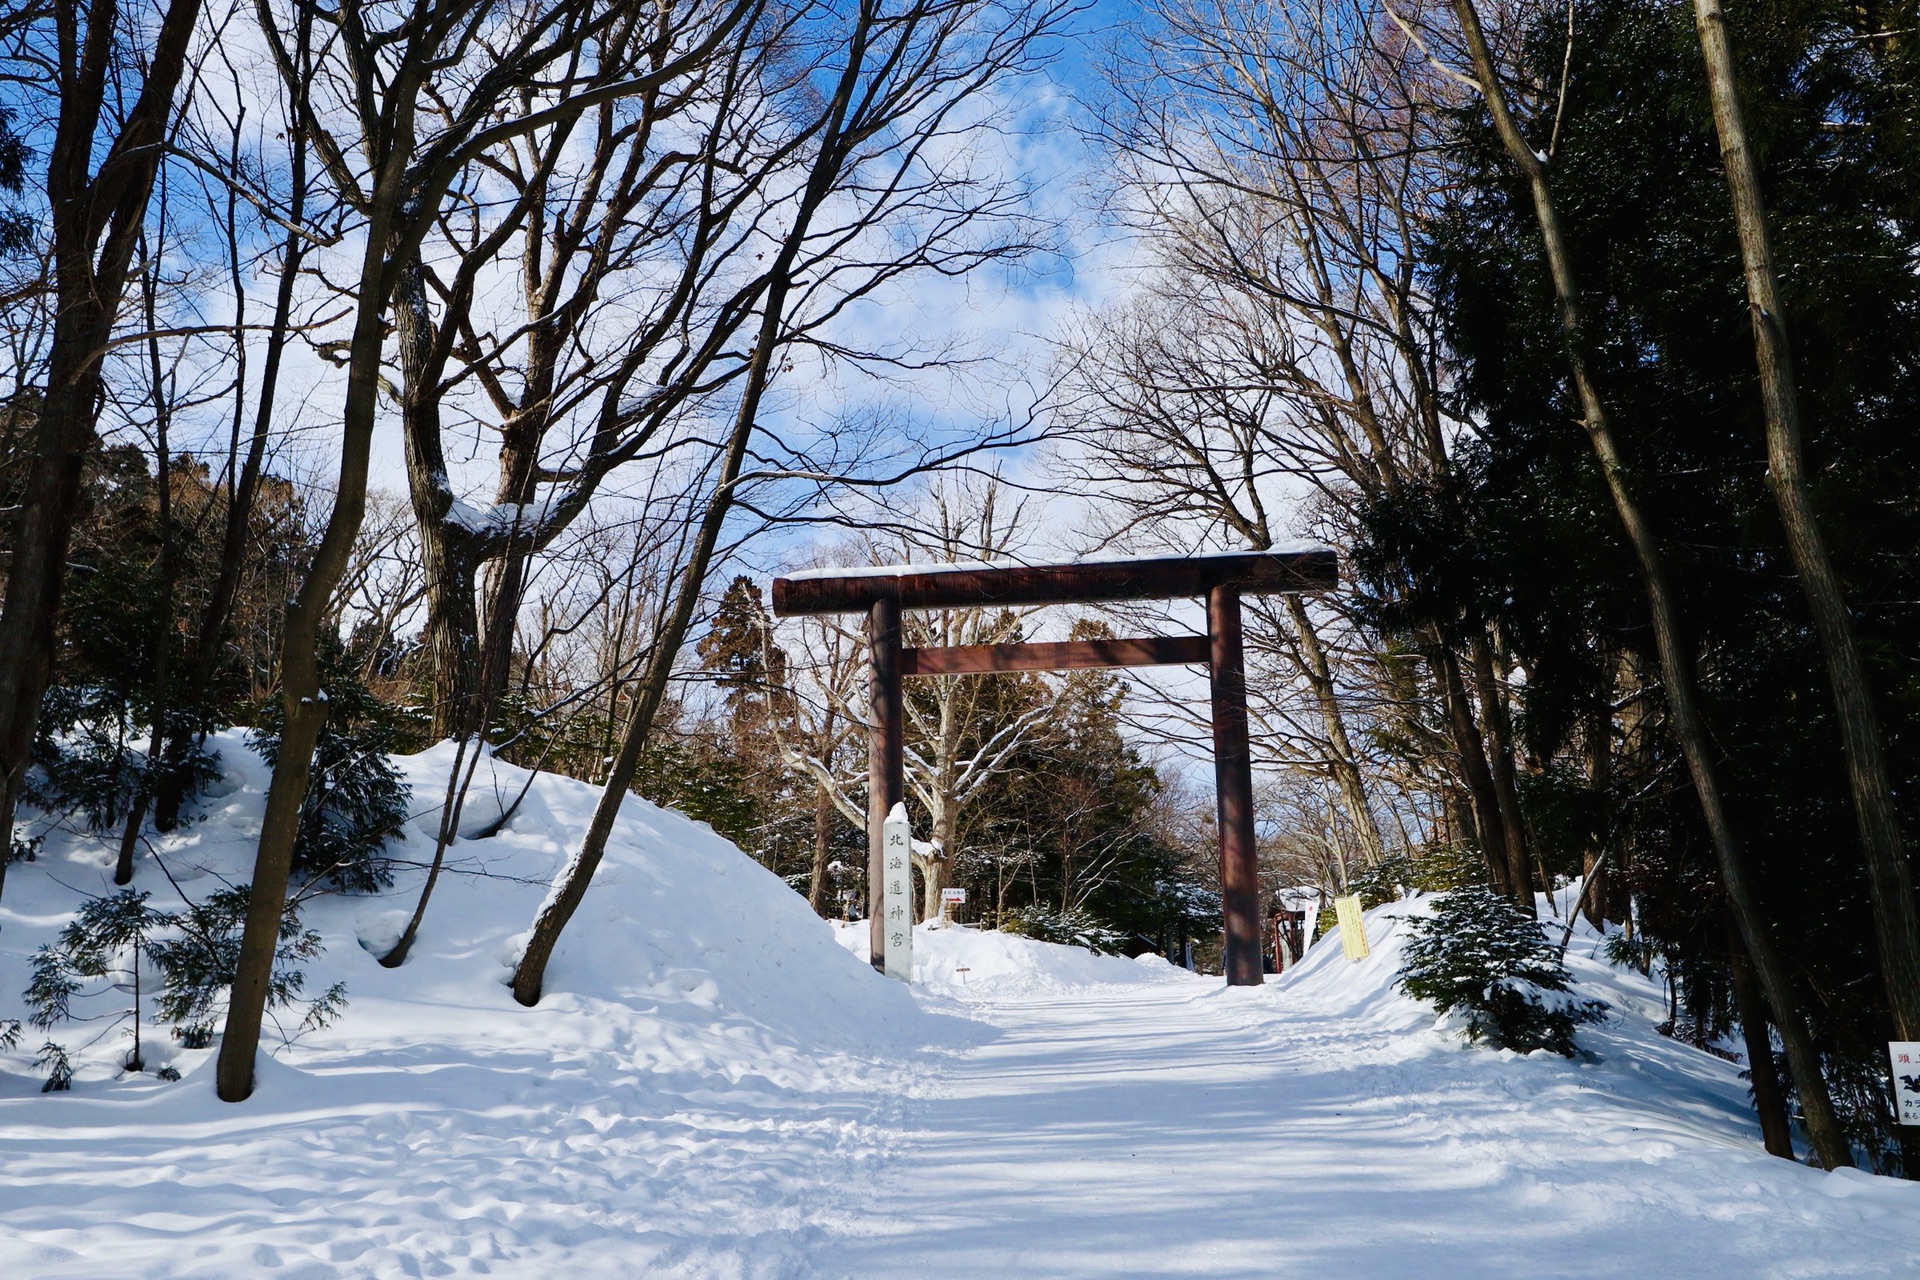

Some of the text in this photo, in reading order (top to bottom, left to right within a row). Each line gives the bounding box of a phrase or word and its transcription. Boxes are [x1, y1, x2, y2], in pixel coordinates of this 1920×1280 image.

[889, 833, 904, 948] 北海道神宮
